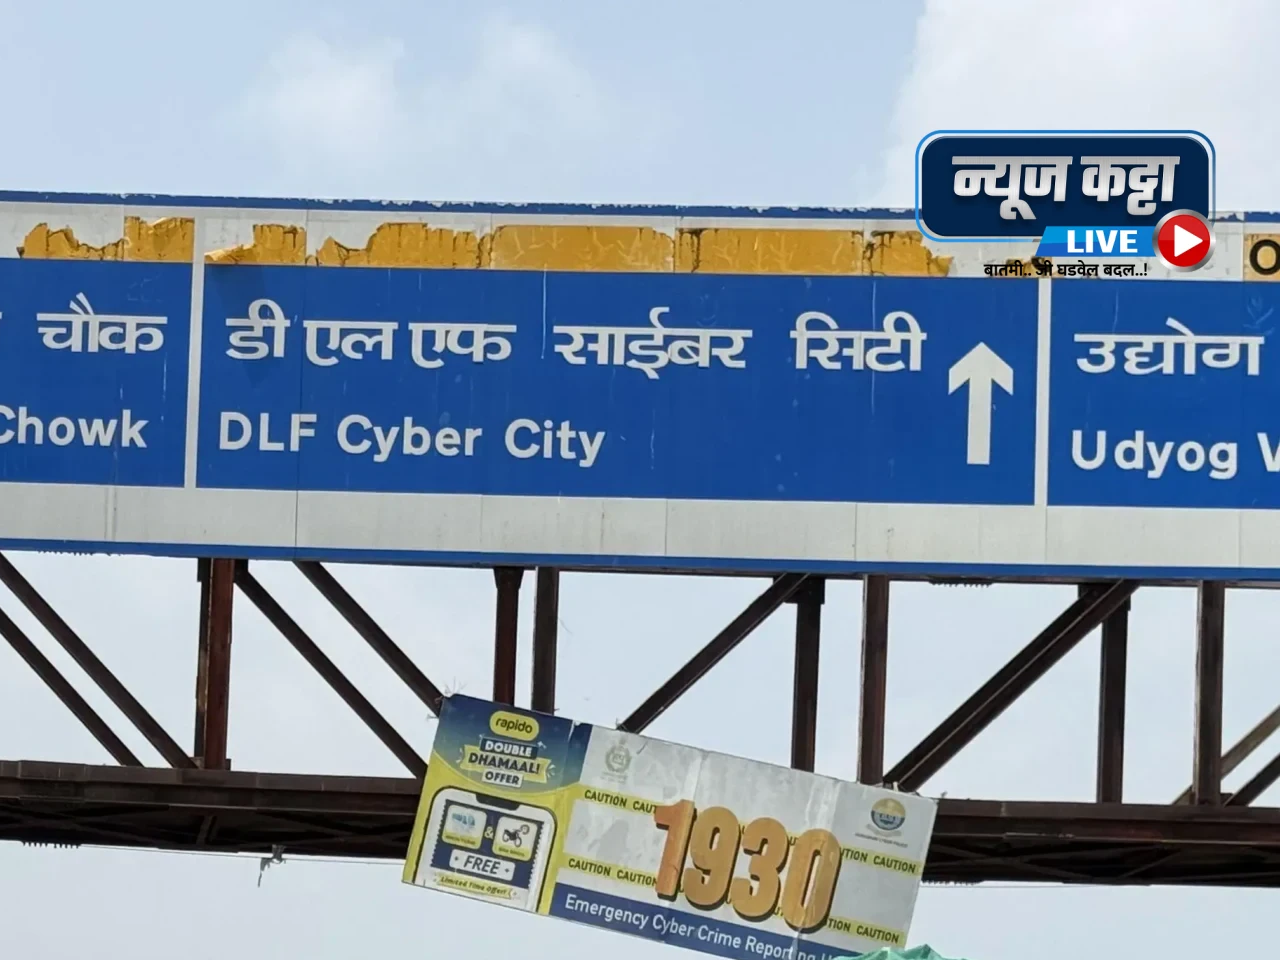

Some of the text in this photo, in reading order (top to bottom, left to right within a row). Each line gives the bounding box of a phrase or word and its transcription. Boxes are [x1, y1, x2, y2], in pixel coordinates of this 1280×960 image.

[36, 292, 168, 354] चौक
[552, 306, 753, 379] साईबर
[789, 311, 927, 372] सिटी
[1073, 317, 1265, 376] उद्योग
[219, 411, 606, 467] DLF Cyber City
[1071, 429, 1239, 480] Udyog
[495, 716, 533, 735] rapido
[484, 740, 533, 757] DOUBLE
[485, 771, 520, 786] OFFER
[584, 789, 627, 808] CAUTION
[463, 855, 501, 875] FREE
[568, 858, 611, 877] CAUTION
[653, 798, 842, 933] 1930
[873, 855, 916, 874] CAUTION
[565, 893, 649, 929] Emergency
[652, 914, 695, 937] Cyber
[697, 924, 742, 949] Crime
[856, 925, 900, 944] CAUTION
